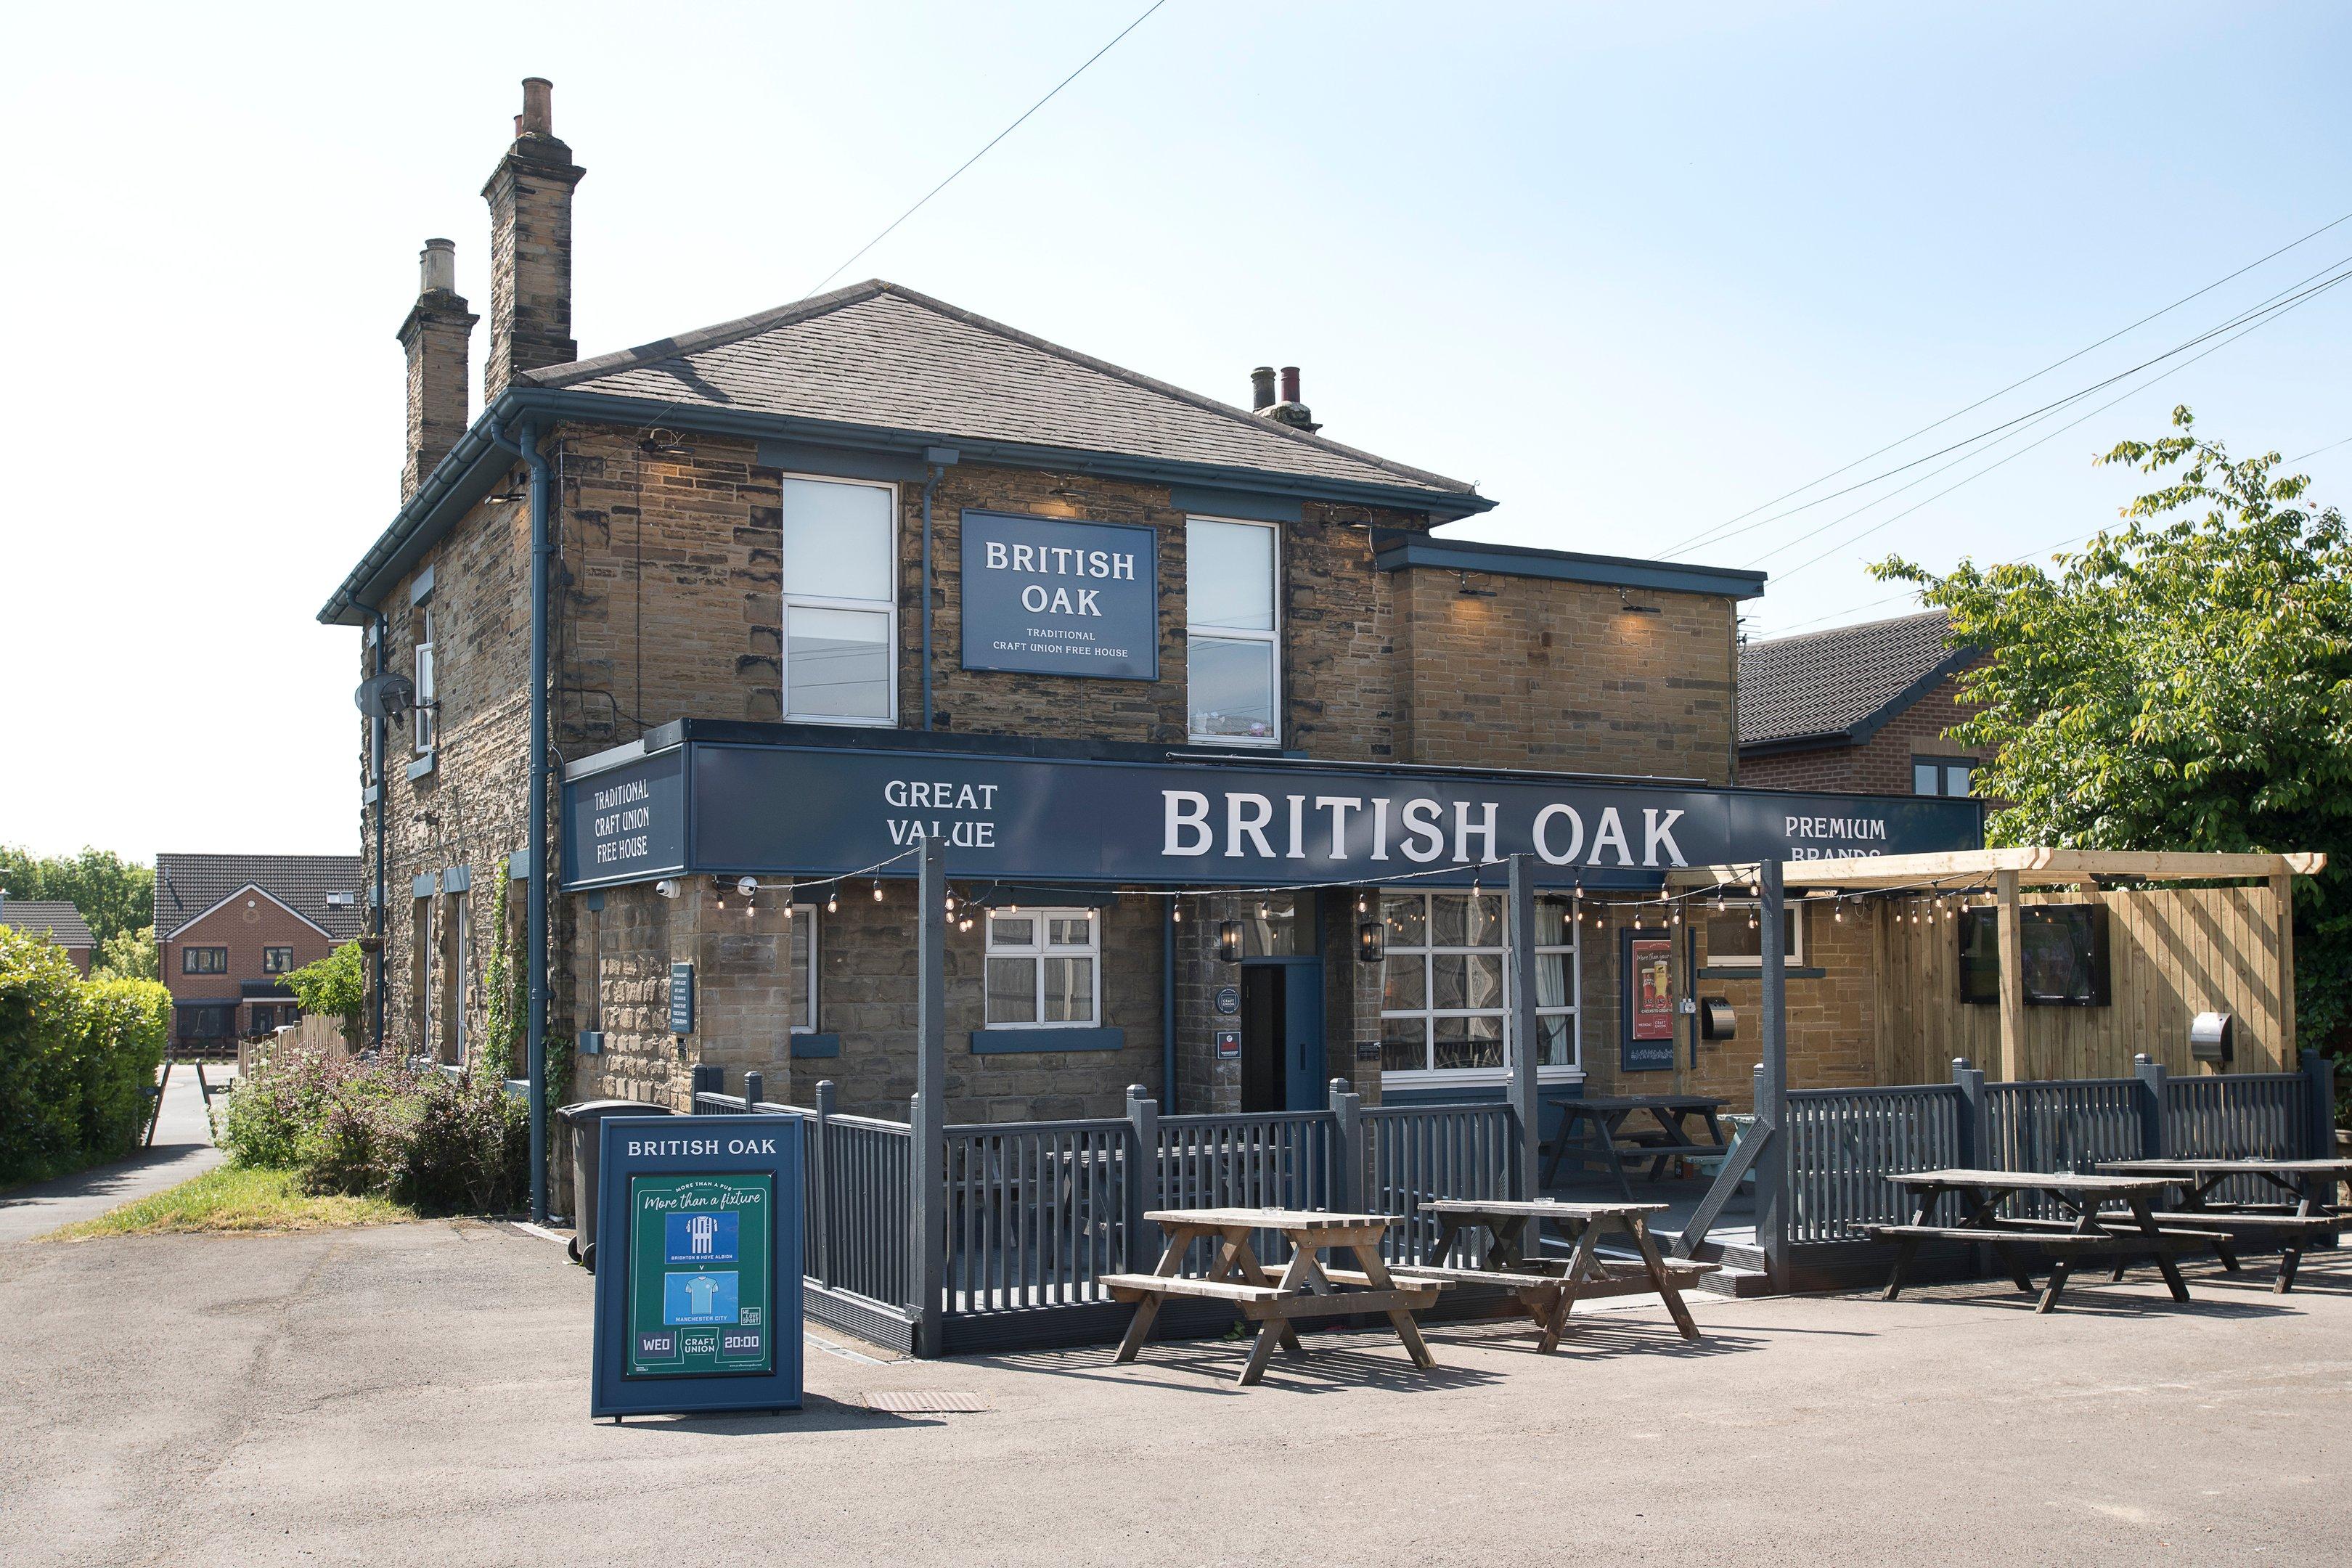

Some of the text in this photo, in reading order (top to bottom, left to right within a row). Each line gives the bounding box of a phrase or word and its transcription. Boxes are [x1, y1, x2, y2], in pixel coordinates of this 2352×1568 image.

[985, 542, 1135, 580] BRITISH
[1021, 585, 1102, 617] OAK
[1027, 628, 1095, 641] TRADITIONAL
[993, 641, 1128, 658] CRAFT UNION FREE HOUSE
[595, 779, 649, 811] TRADITIONAL
[884, 780, 998, 810] GREAT
[595, 807, 649, 837] CRAFT UNION
[886, 820, 995, 848] VALUE
[1161, 790, 1689, 867] BRITISH OAK
[1785, 816, 1886, 840] PREMIUM
[597, 836, 648, 863] FREE HOUSE
[628, 1139, 776, 1156] BRITISH OAK
[675, 1183, 694, 1192] MORE
[644, 1197, 677, 1210] More
[680, 1192, 708, 1208] than
[720, 1191, 761, 1210] fixture
[643, 1339, 670, 1351] WED
[725, 1336, 759, 1348] 20:00
